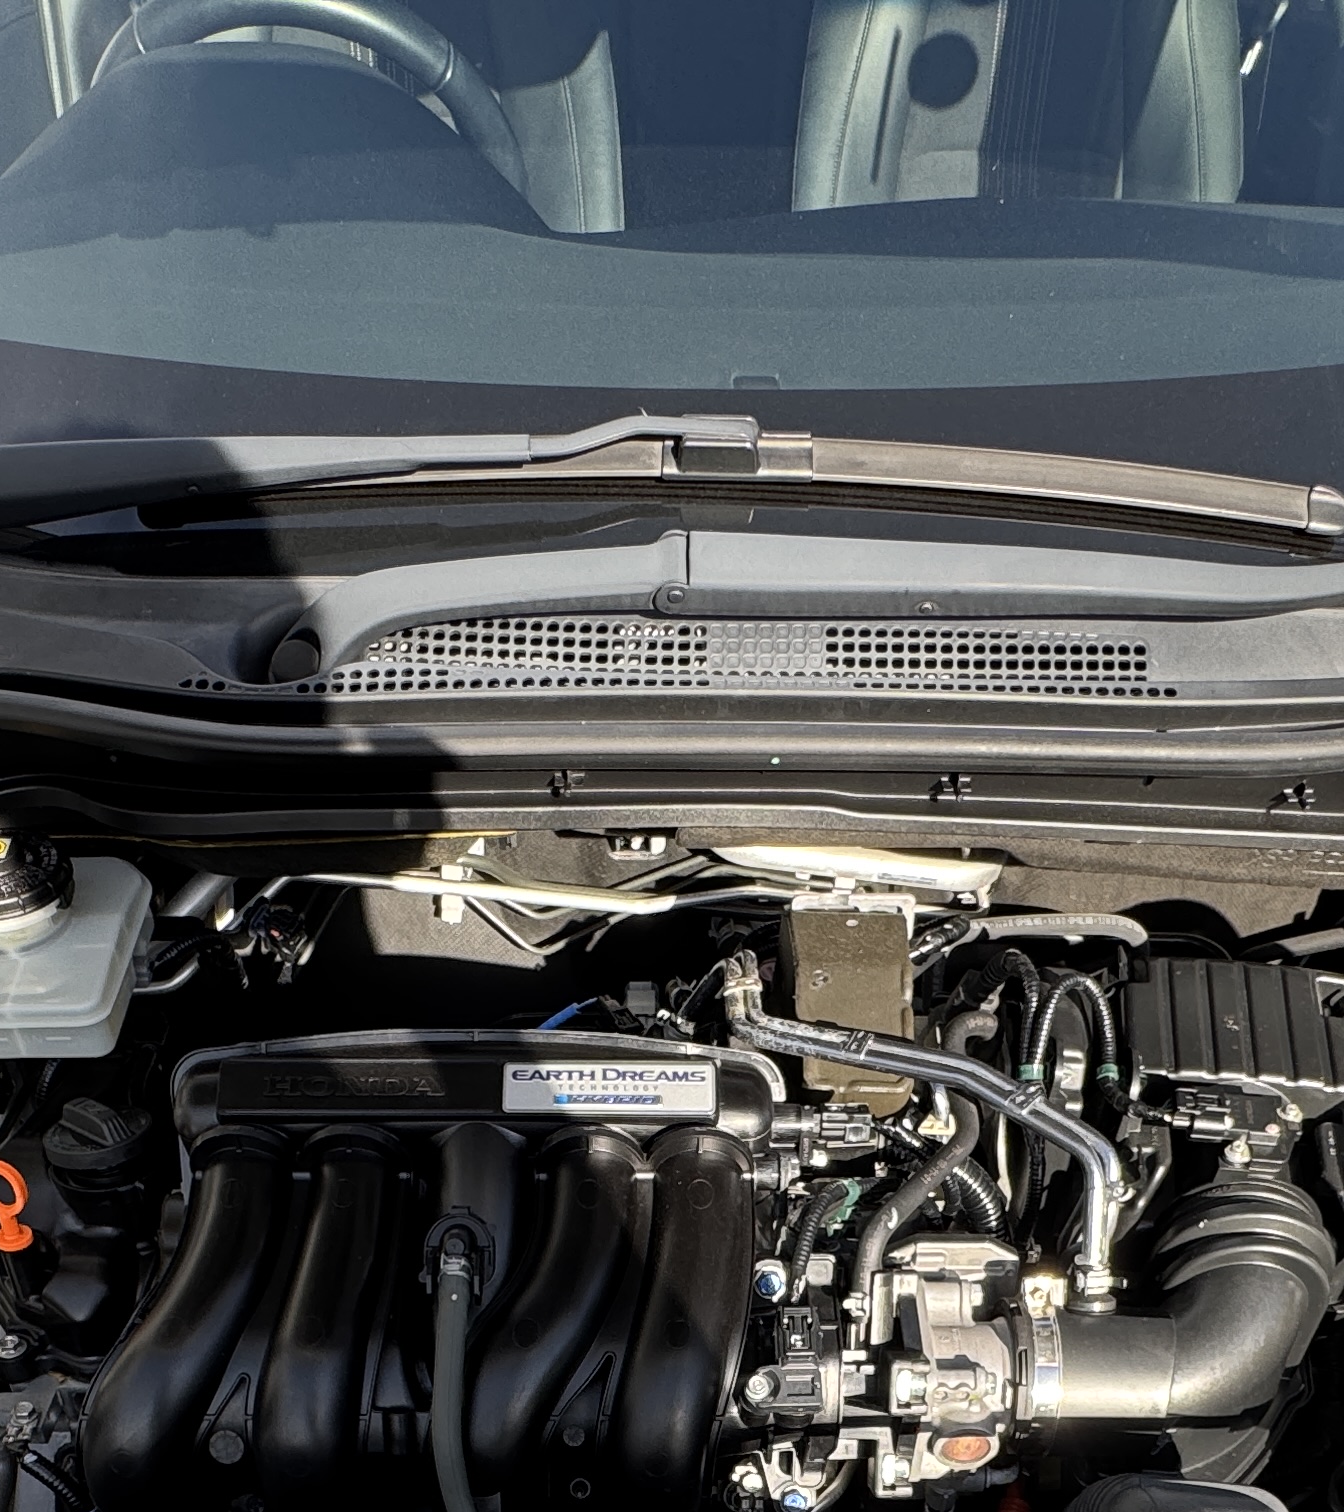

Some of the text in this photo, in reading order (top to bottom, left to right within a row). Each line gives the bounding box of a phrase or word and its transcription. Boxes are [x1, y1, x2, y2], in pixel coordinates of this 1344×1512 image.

[511, 1069, 596, 1082] EARTH
[262, 1075, 445, 1097] HONDA
[558, 1084, 659, 1092] TECHNOLOGY
